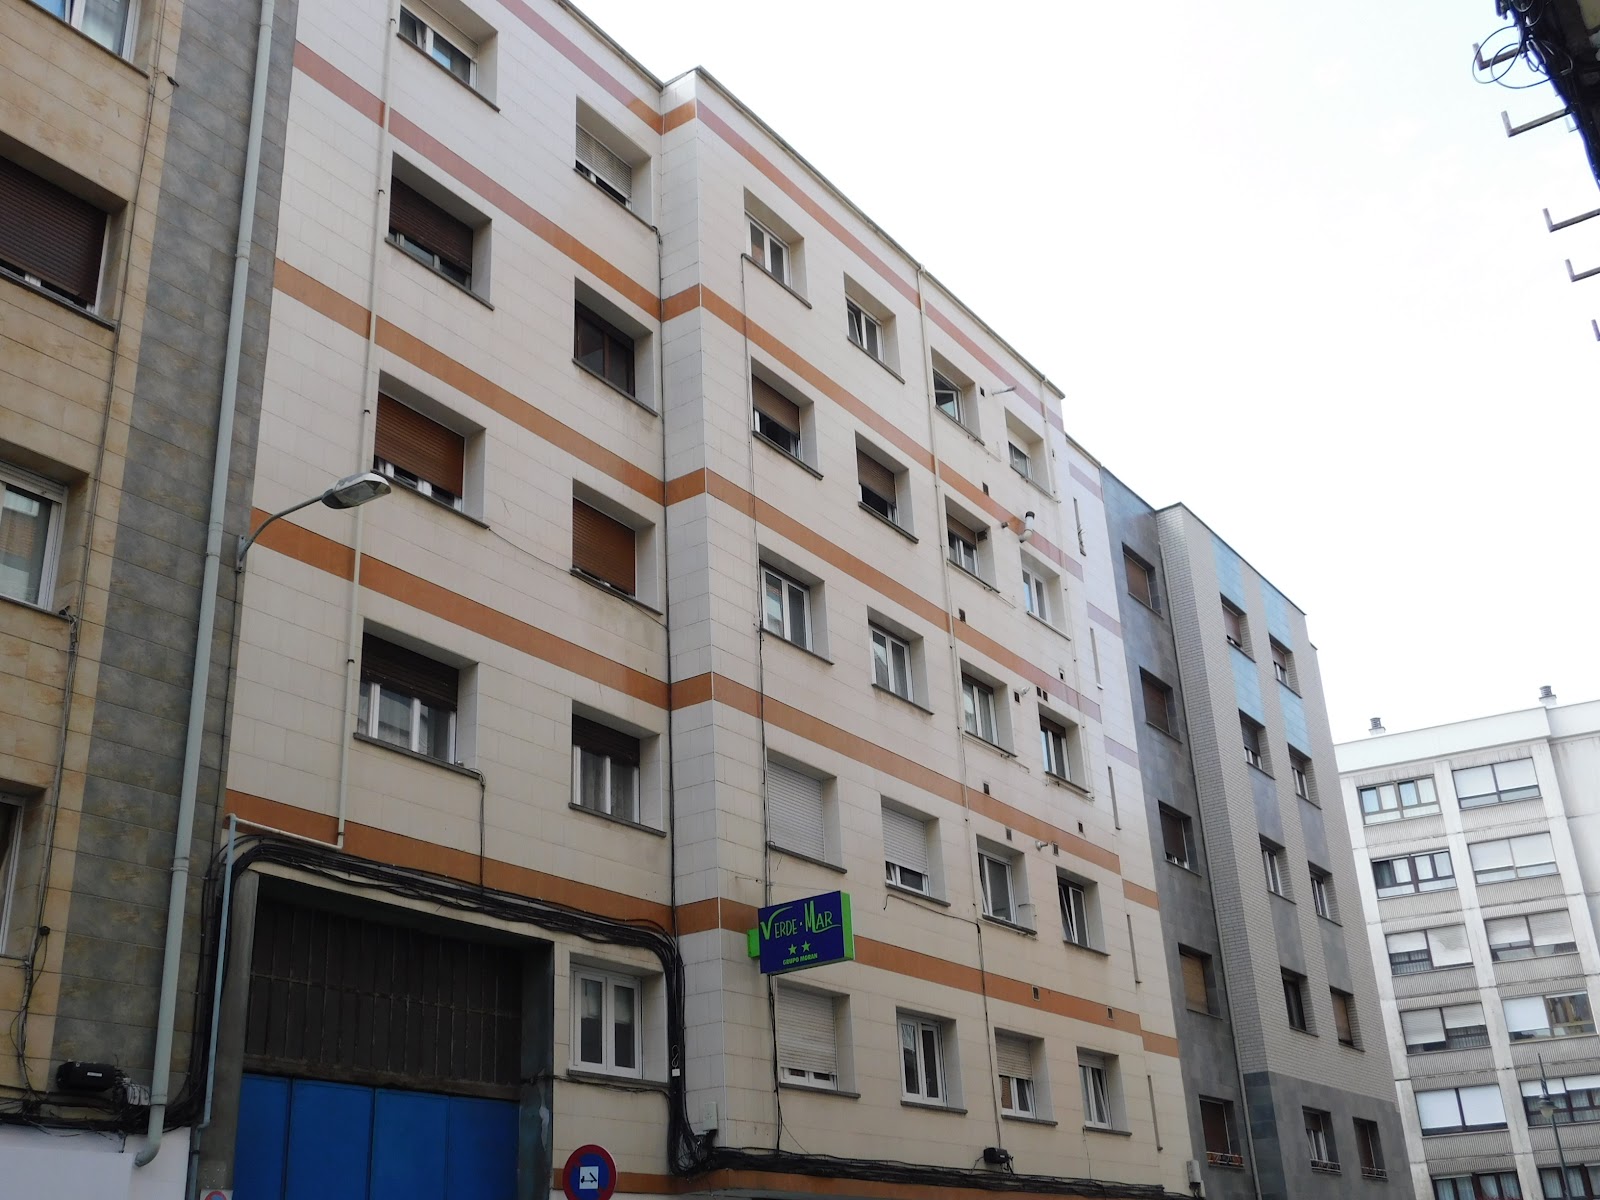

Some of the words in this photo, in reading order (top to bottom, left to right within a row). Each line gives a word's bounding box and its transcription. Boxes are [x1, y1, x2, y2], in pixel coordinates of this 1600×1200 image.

[760, 906, 798, 940] VERDE
[804, 900, 841, 934] MAR
[783, 957, 799, 965] GRUPO
